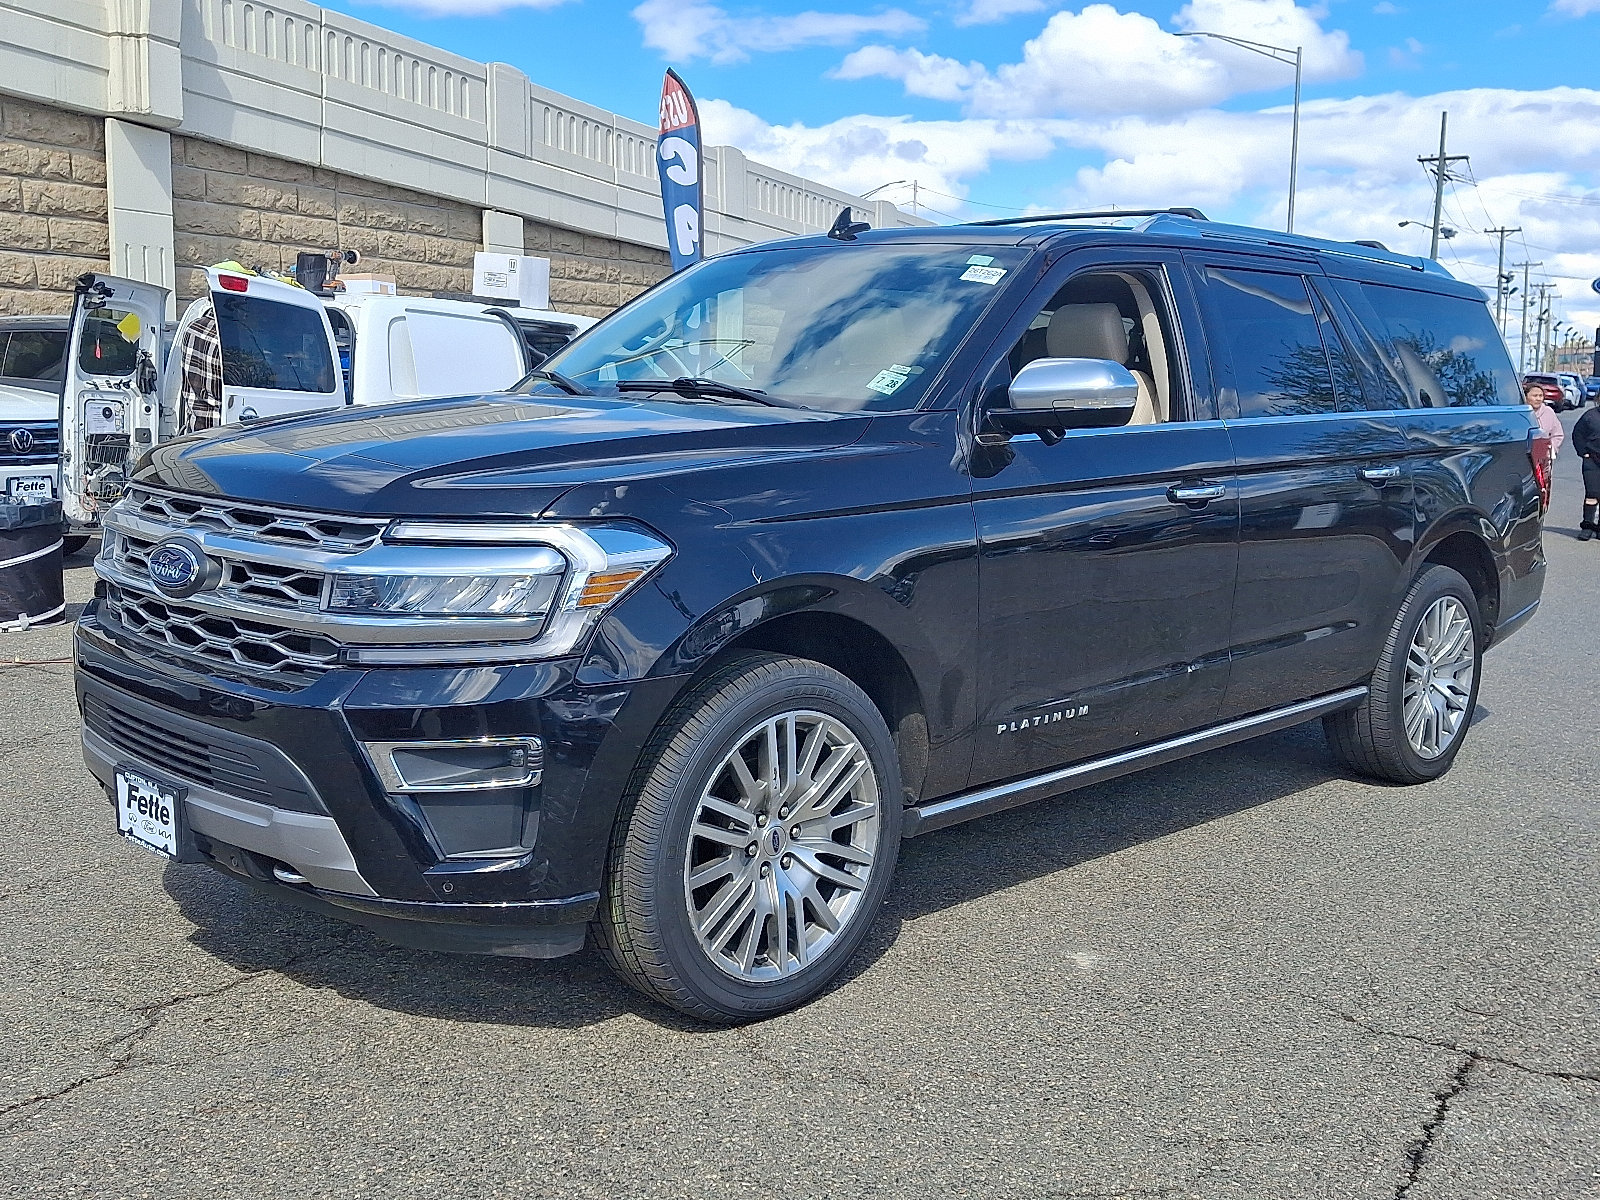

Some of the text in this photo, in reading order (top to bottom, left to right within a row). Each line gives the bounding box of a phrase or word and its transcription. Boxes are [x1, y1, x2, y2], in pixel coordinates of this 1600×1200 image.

[877, 376, 886, 384] 7
[885, 380, 899, 389] 28
[16, 481, 46, 492] Fette
[154, 552, 184, 580] Ford
[997, 705, 1089, 734] PLATINUM
[127, 783, 170, 825] Fette
